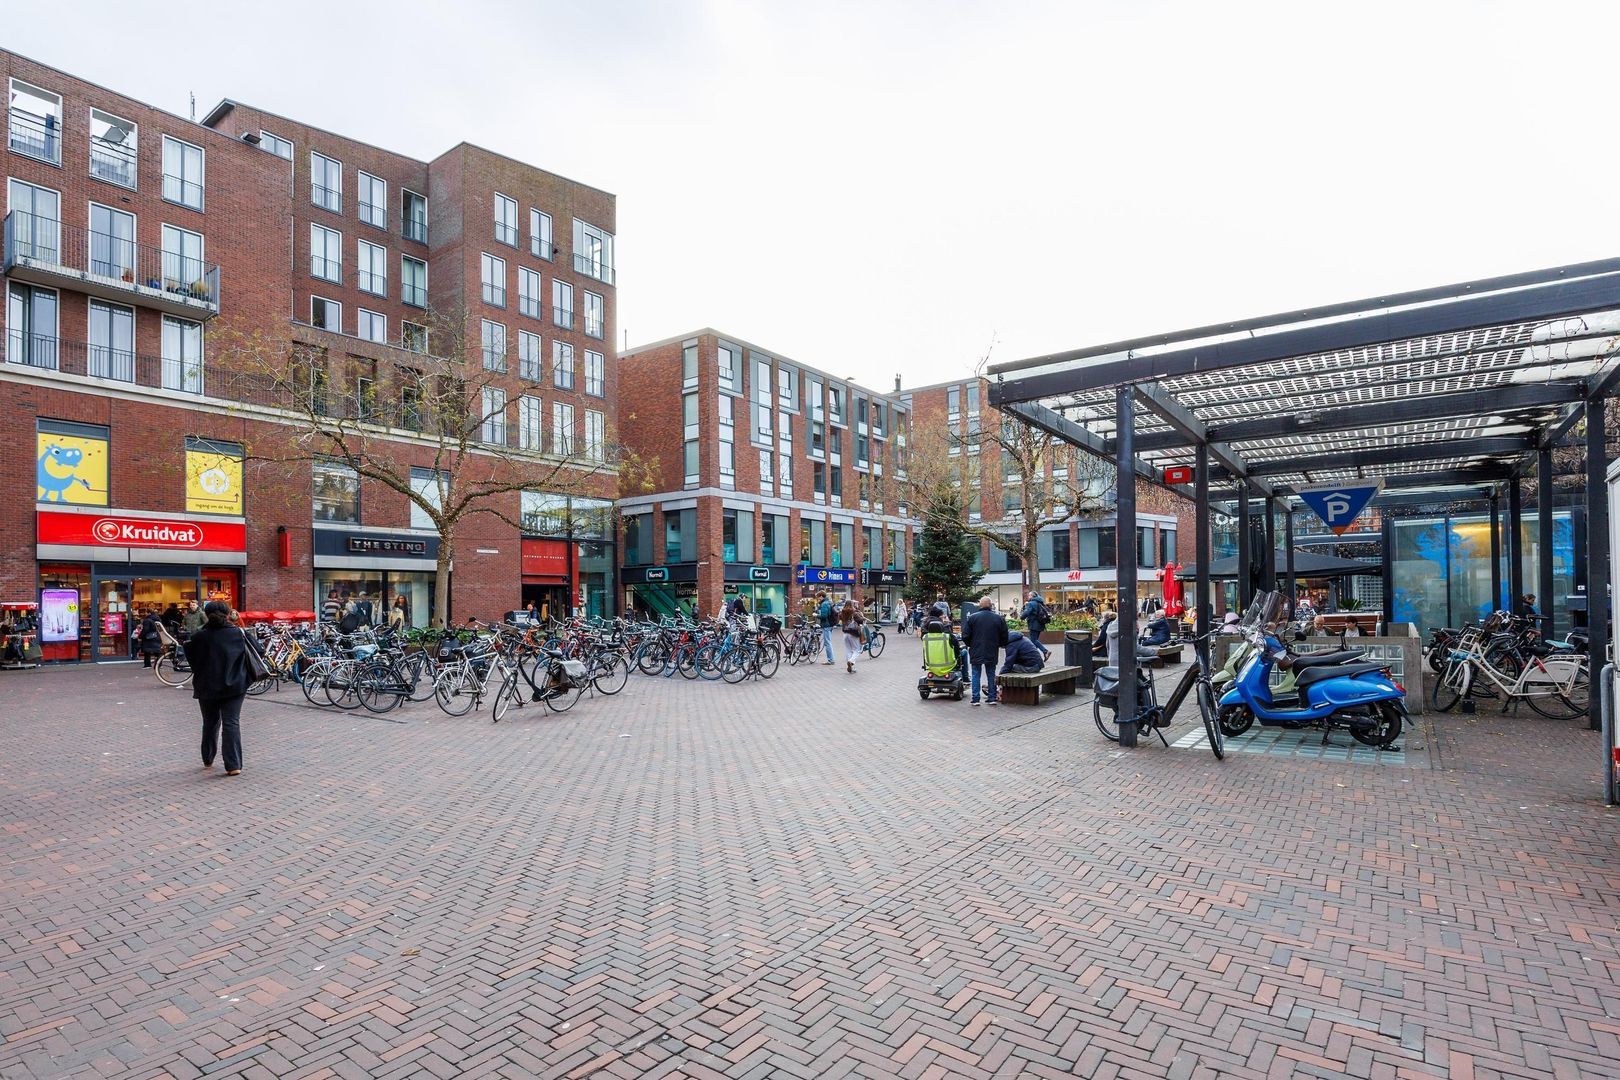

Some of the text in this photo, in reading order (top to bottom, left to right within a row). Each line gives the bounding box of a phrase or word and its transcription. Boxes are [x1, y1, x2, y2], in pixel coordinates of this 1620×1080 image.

[1327, 501, 1349, 522] P
[122, 524, 196, 542] Kruidvat
[354, 540, 422, 551] THE STING
[828, 571, 843, 580] Primera
